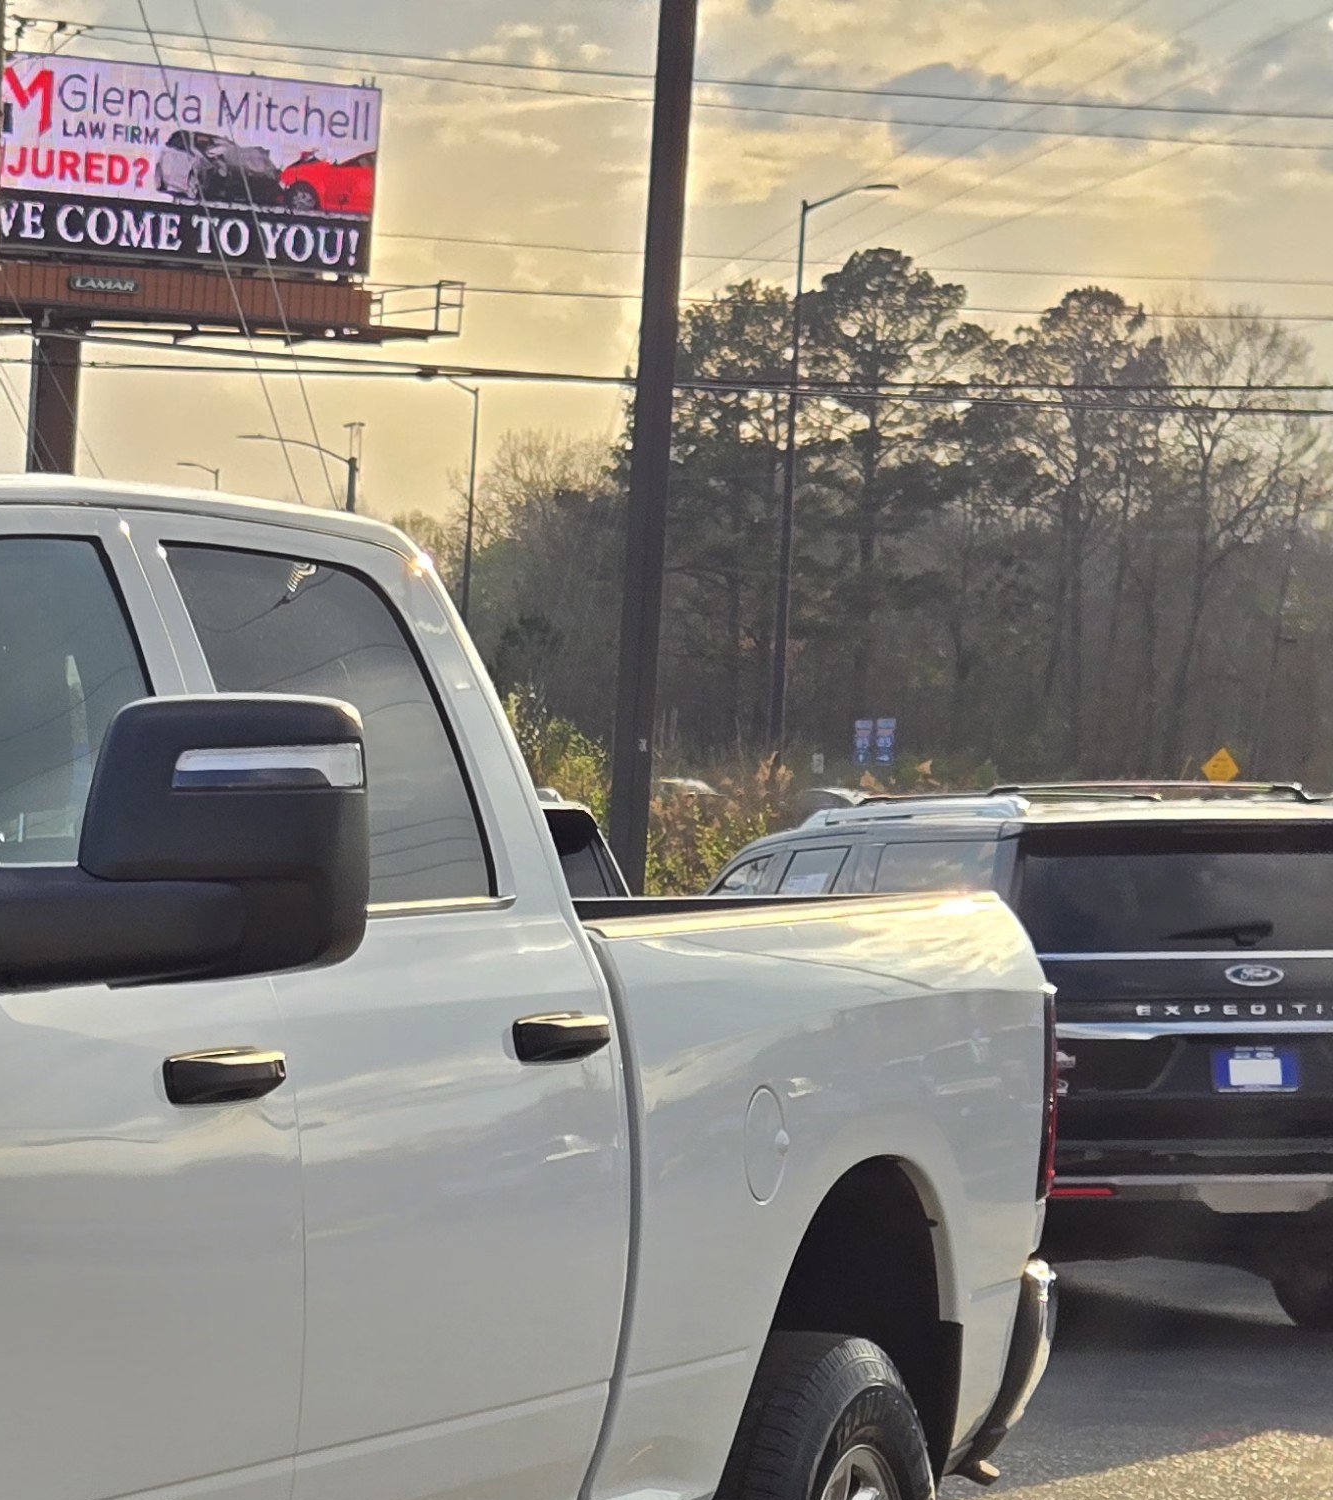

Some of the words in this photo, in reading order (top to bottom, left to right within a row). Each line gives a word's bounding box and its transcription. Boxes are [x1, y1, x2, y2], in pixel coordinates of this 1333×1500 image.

[58, 72, 201, 124] Glenda
[218, 90, 370, 141] Mitchell
[63, 119, 106, 139] LAW
[113, 124, 160, 145] FIRM
[0, 147, 150, 188] JURED?
[56, 205, 182, 250] COME
[192, 215, 249, 256] TO
[260, 221, 359, 267] YOU!
[75, 277, 136, 291] LAMAR
[1135, 1004, 1333, 1017] EXPEDITI
